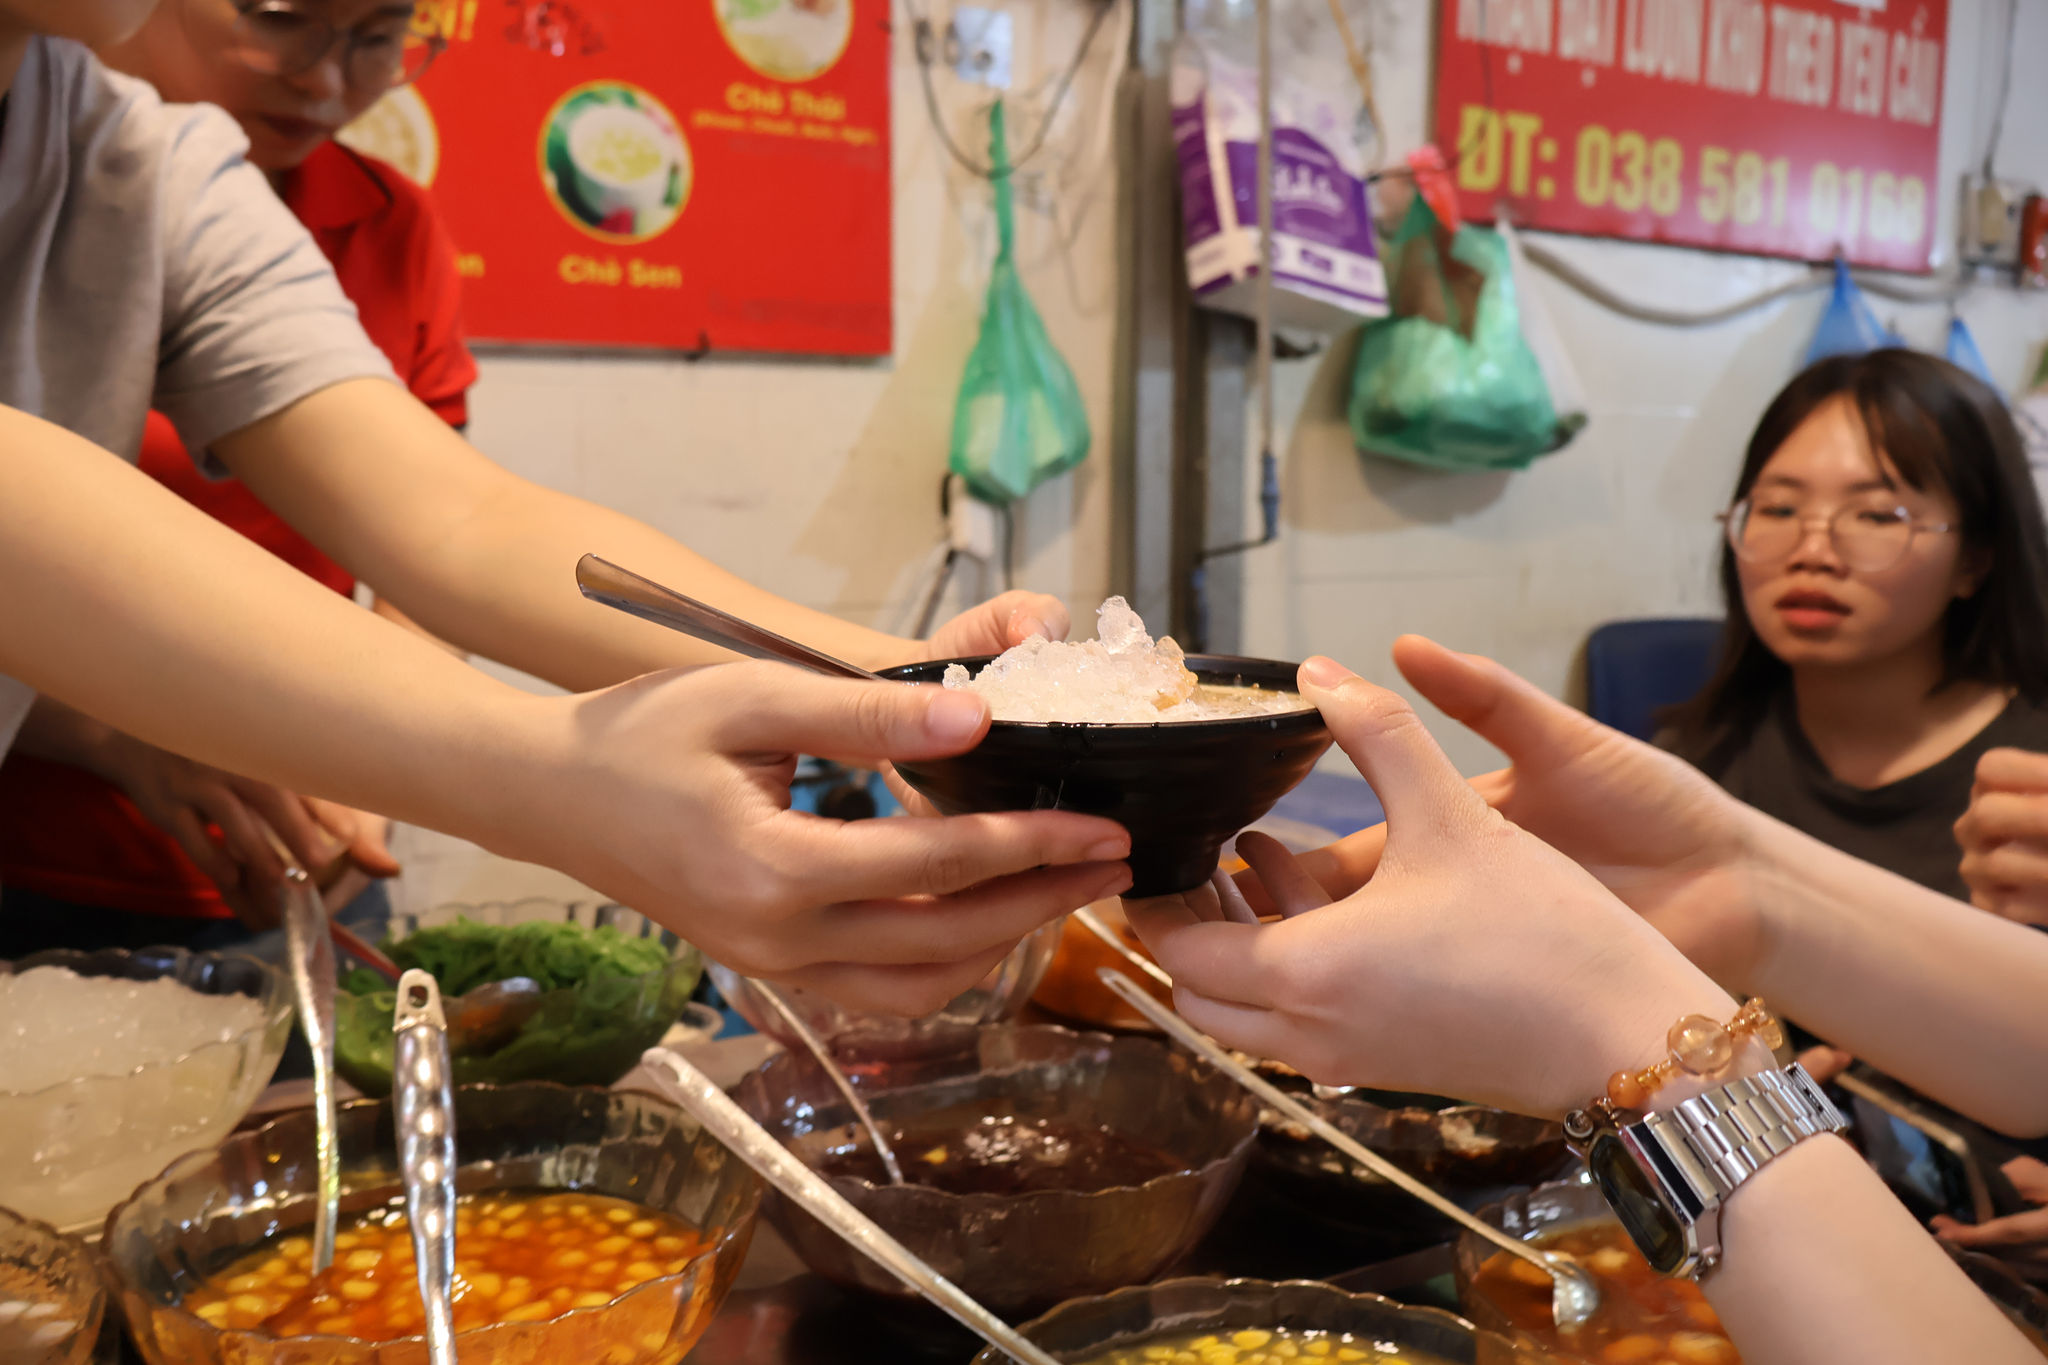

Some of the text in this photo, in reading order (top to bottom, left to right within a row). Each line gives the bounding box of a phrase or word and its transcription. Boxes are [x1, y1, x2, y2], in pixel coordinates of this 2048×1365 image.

[1768, 3, 1835, 109] THEO
[1457, 104, 1558, 200] ĐT:
[1574, 123, 1683, 216] 038
[1698, 144, 1790, 229] 581
[559, 254, 682, 288] Chè Sen
